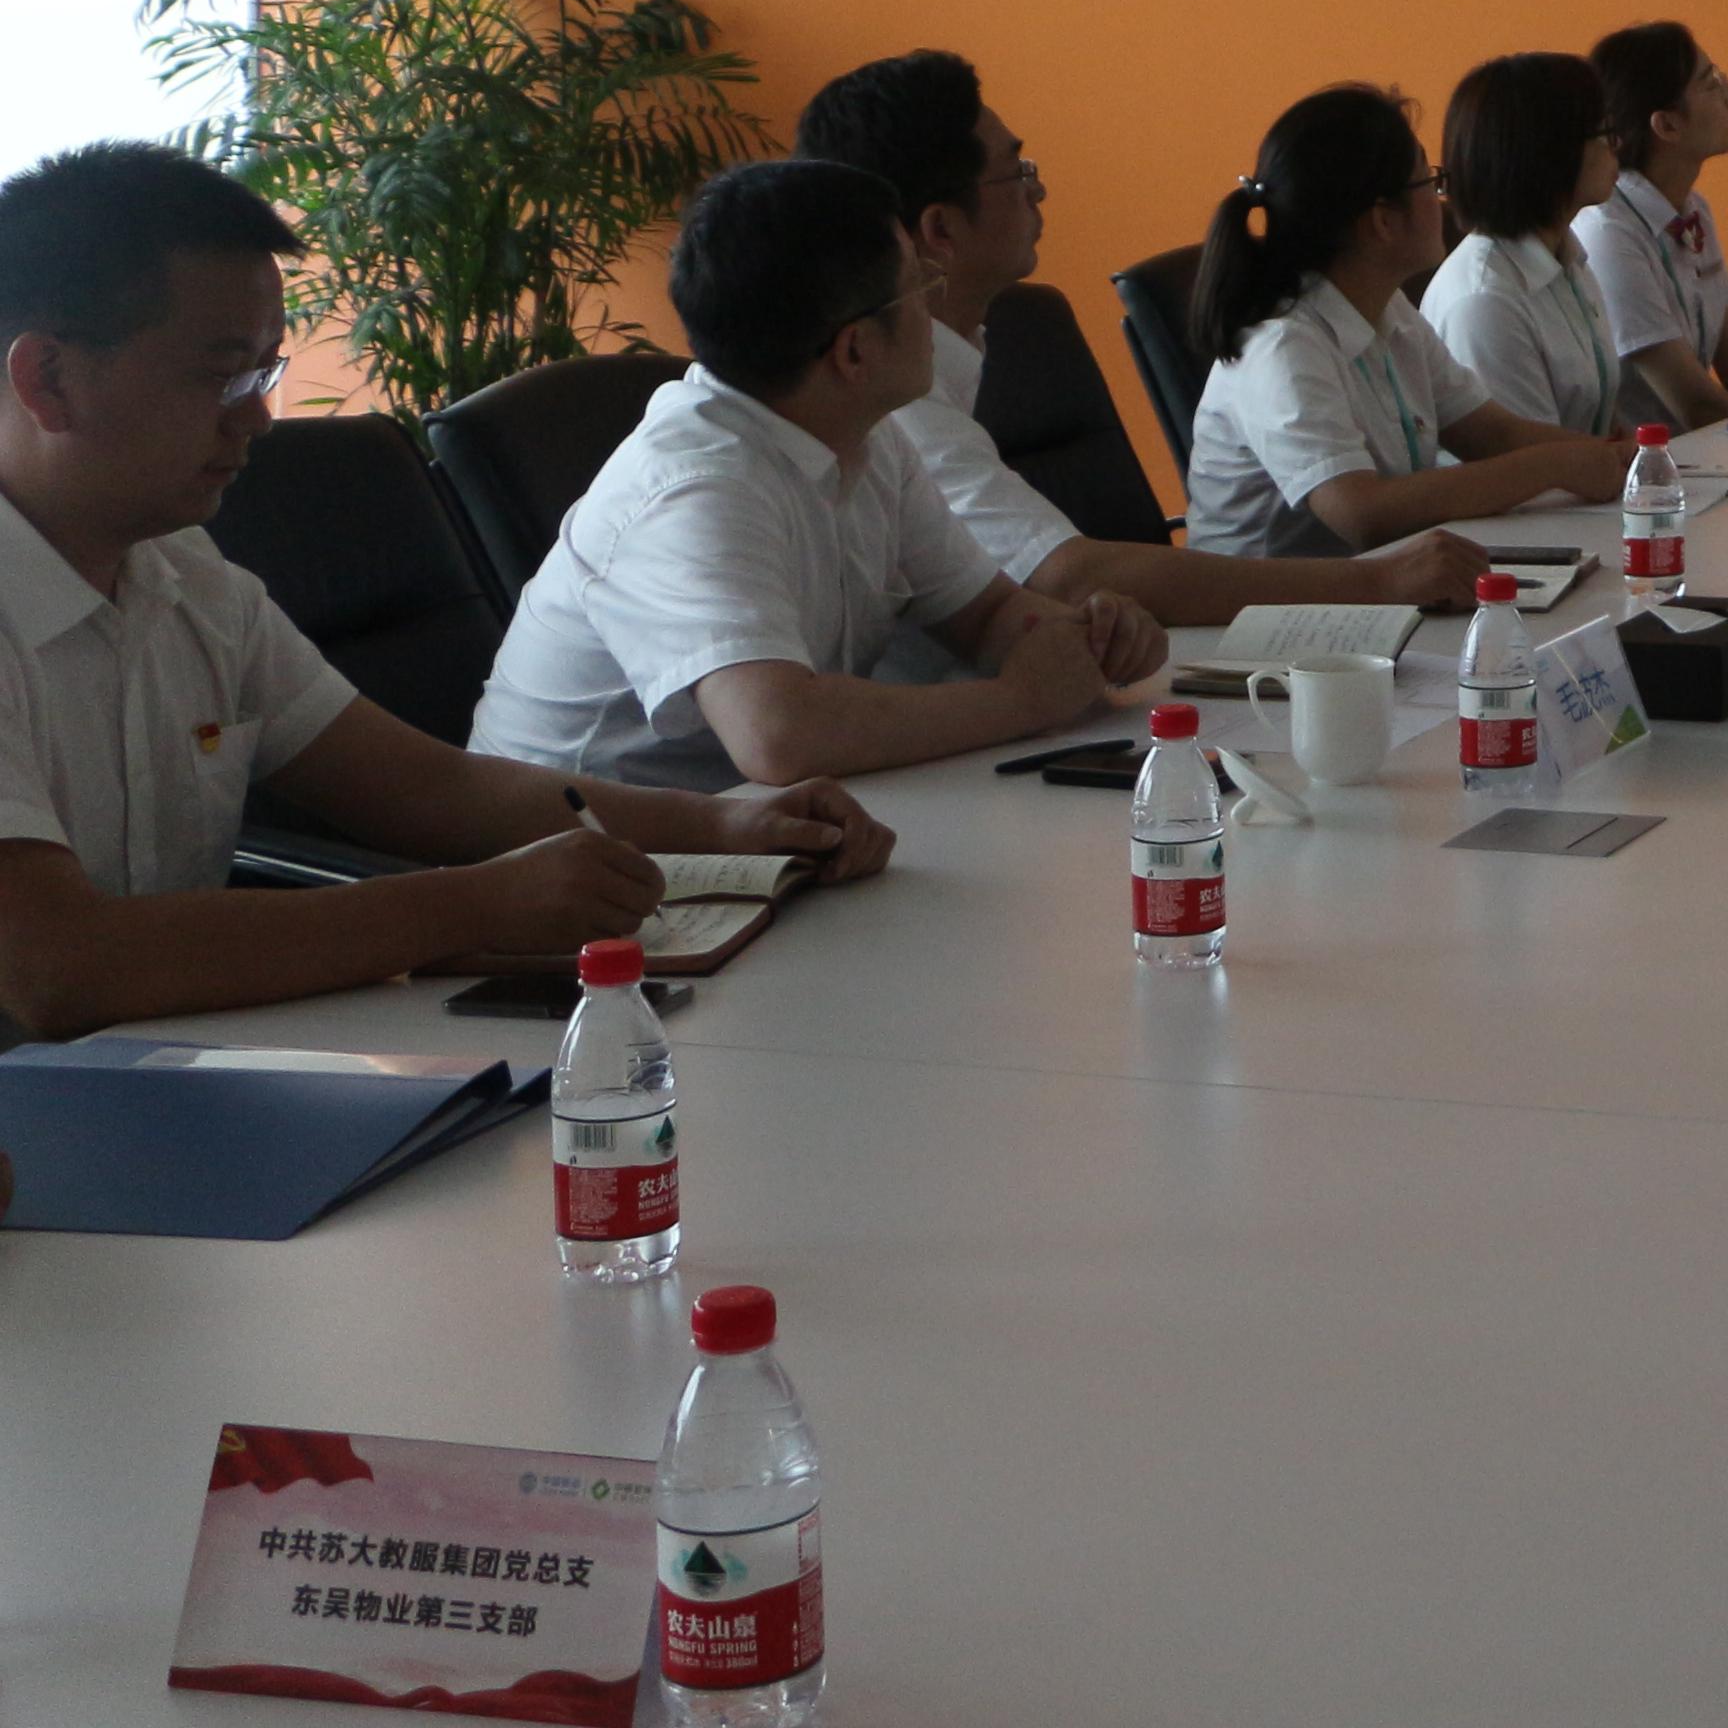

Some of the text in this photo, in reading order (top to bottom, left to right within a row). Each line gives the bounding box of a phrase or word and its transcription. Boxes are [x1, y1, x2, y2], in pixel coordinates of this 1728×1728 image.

[259, 1527, 594, 1588] 中共苏大教服集团党总支
[291, 1583, 540, 1636] 东吴物业第三支部
[667, 1608, 758, 1640] 农夫山泉
[710, 1639, 757, 1655] SPRING
